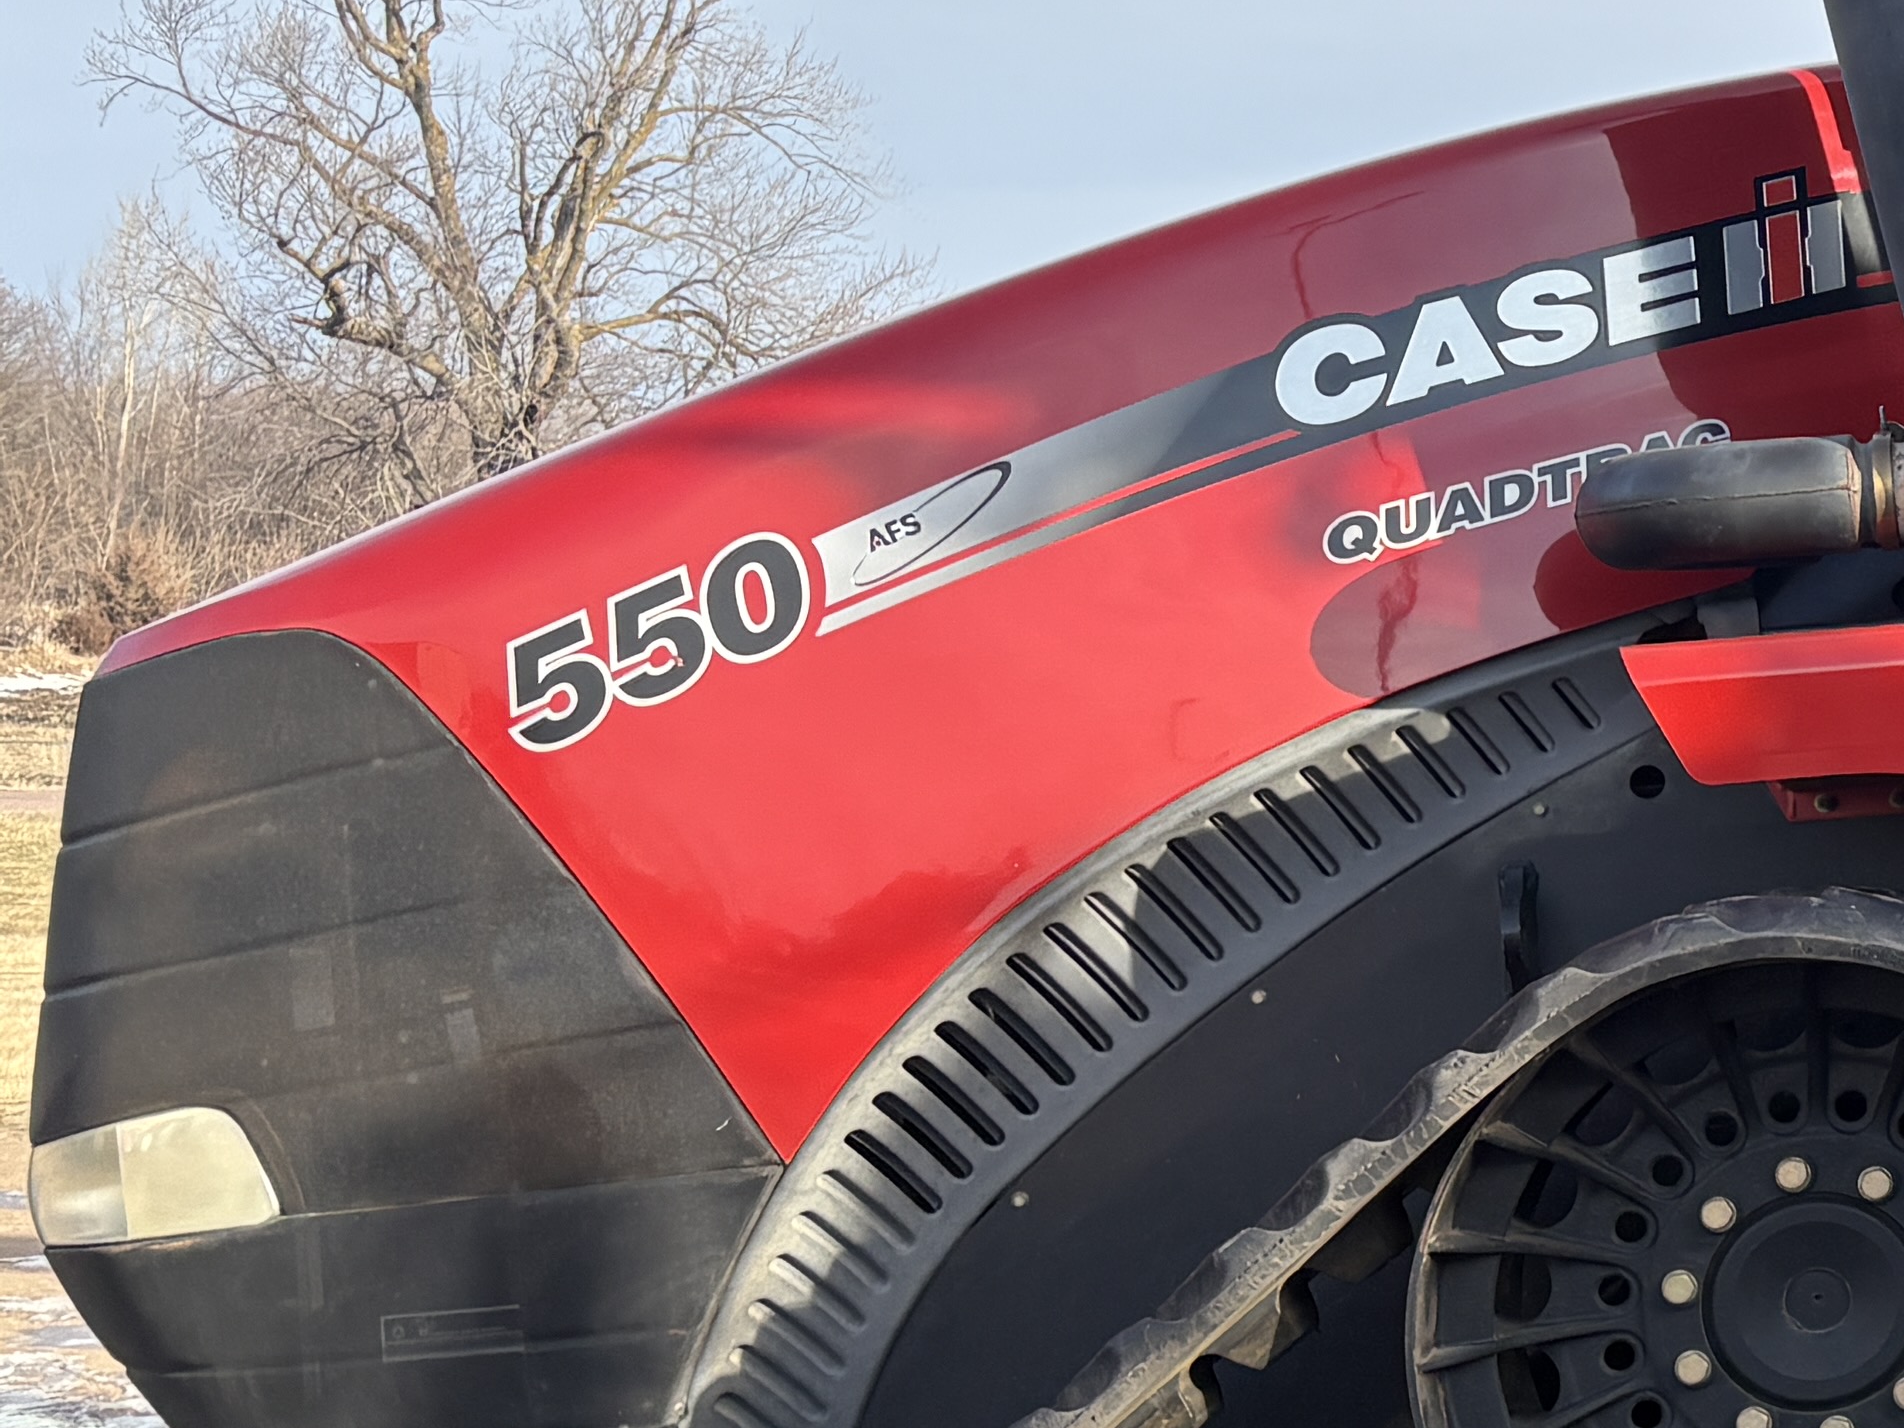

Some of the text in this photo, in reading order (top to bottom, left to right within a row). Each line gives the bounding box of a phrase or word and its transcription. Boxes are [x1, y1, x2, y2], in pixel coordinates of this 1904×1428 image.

[1275, 235, 1701, 425] CASE
[868, 510, 923, 554] AFS
[1323, 419, 1731, 564] QUADT
[505, 531, 811, 753] 550
